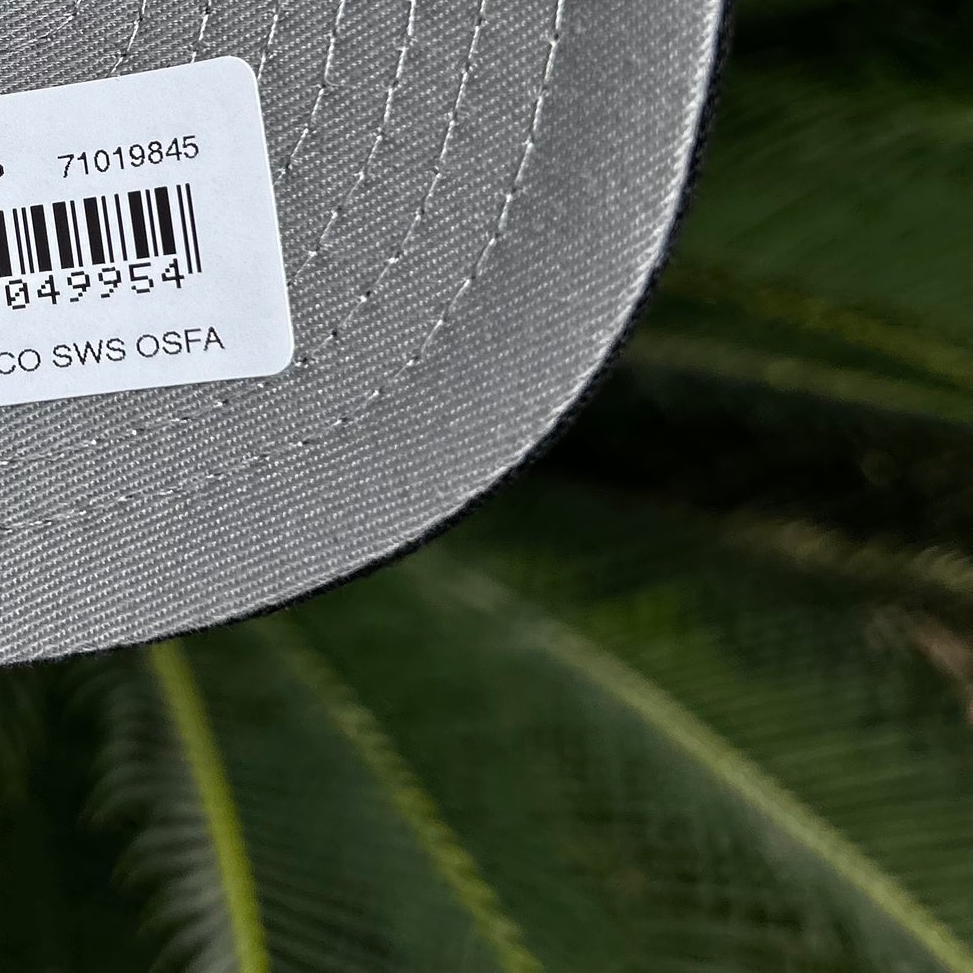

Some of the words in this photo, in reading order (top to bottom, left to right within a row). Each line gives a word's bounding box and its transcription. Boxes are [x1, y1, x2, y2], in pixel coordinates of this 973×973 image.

[57, 135, 200, 178] 71019845
[4, 258, 186, 310] 049954
[51, 338, 127, 369] SWS
[135, 326, 225, 358] OSFA
